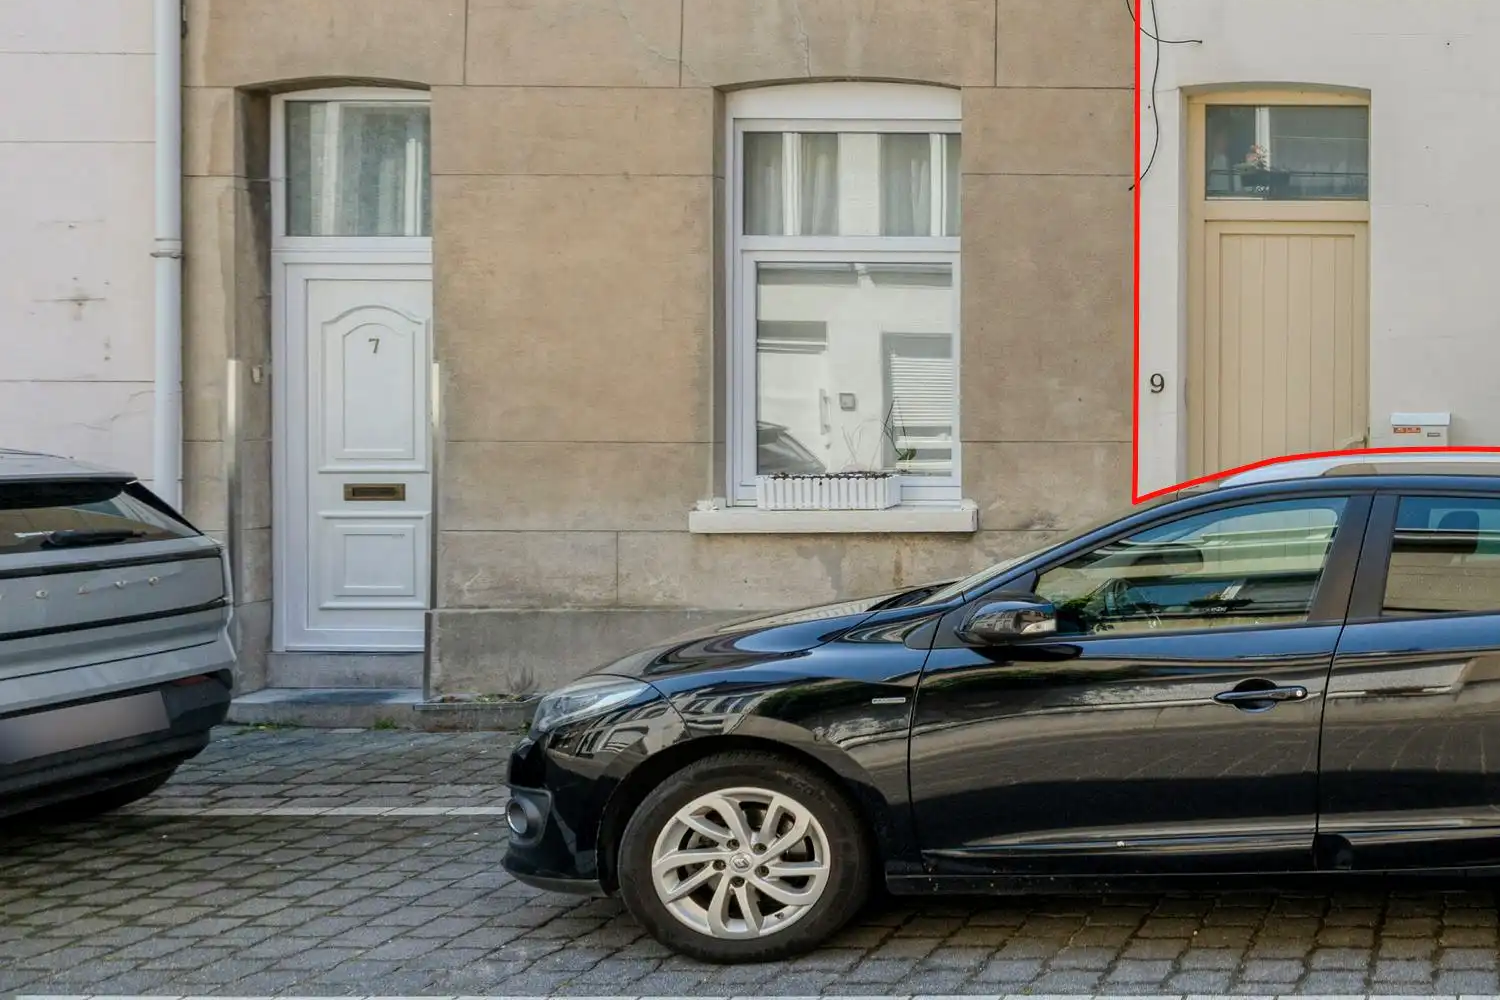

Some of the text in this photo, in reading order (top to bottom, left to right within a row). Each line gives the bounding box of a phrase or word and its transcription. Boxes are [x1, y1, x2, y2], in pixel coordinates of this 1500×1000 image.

[368, 338, 380, 354] 7
[1149, 373, 1166, 394] 9
[0, 576, 160, 601] OLVO
